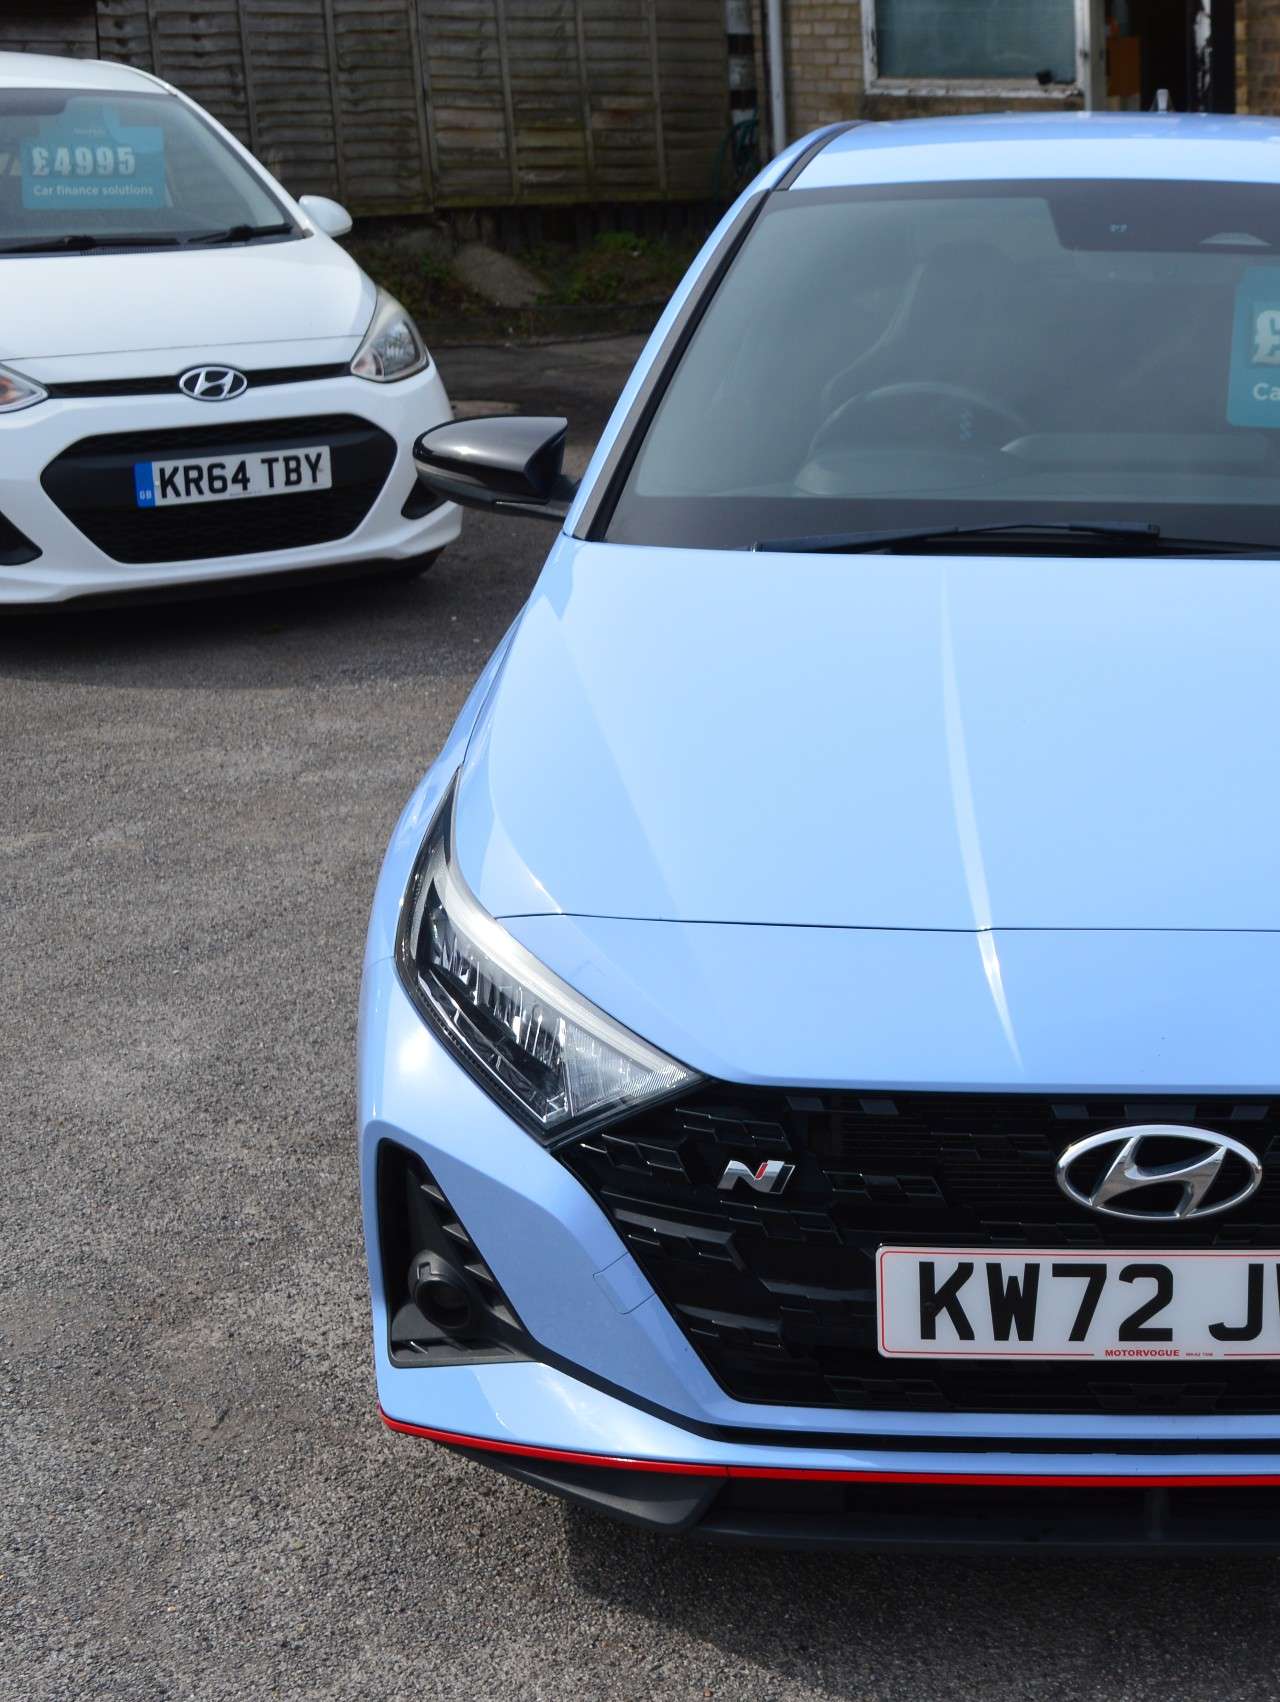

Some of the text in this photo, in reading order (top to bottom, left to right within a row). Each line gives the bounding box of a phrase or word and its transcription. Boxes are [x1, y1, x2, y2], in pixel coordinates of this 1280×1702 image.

[32, 146, 136, 176] £4995
[32, 183, 153, 197] Car finance solutions
[158, 452, 323, 499] KR64 TBY
[918, 1260, 1174, 1342] KW72
[1104, 1348, 1180, 1358] MOTORVOGUE
